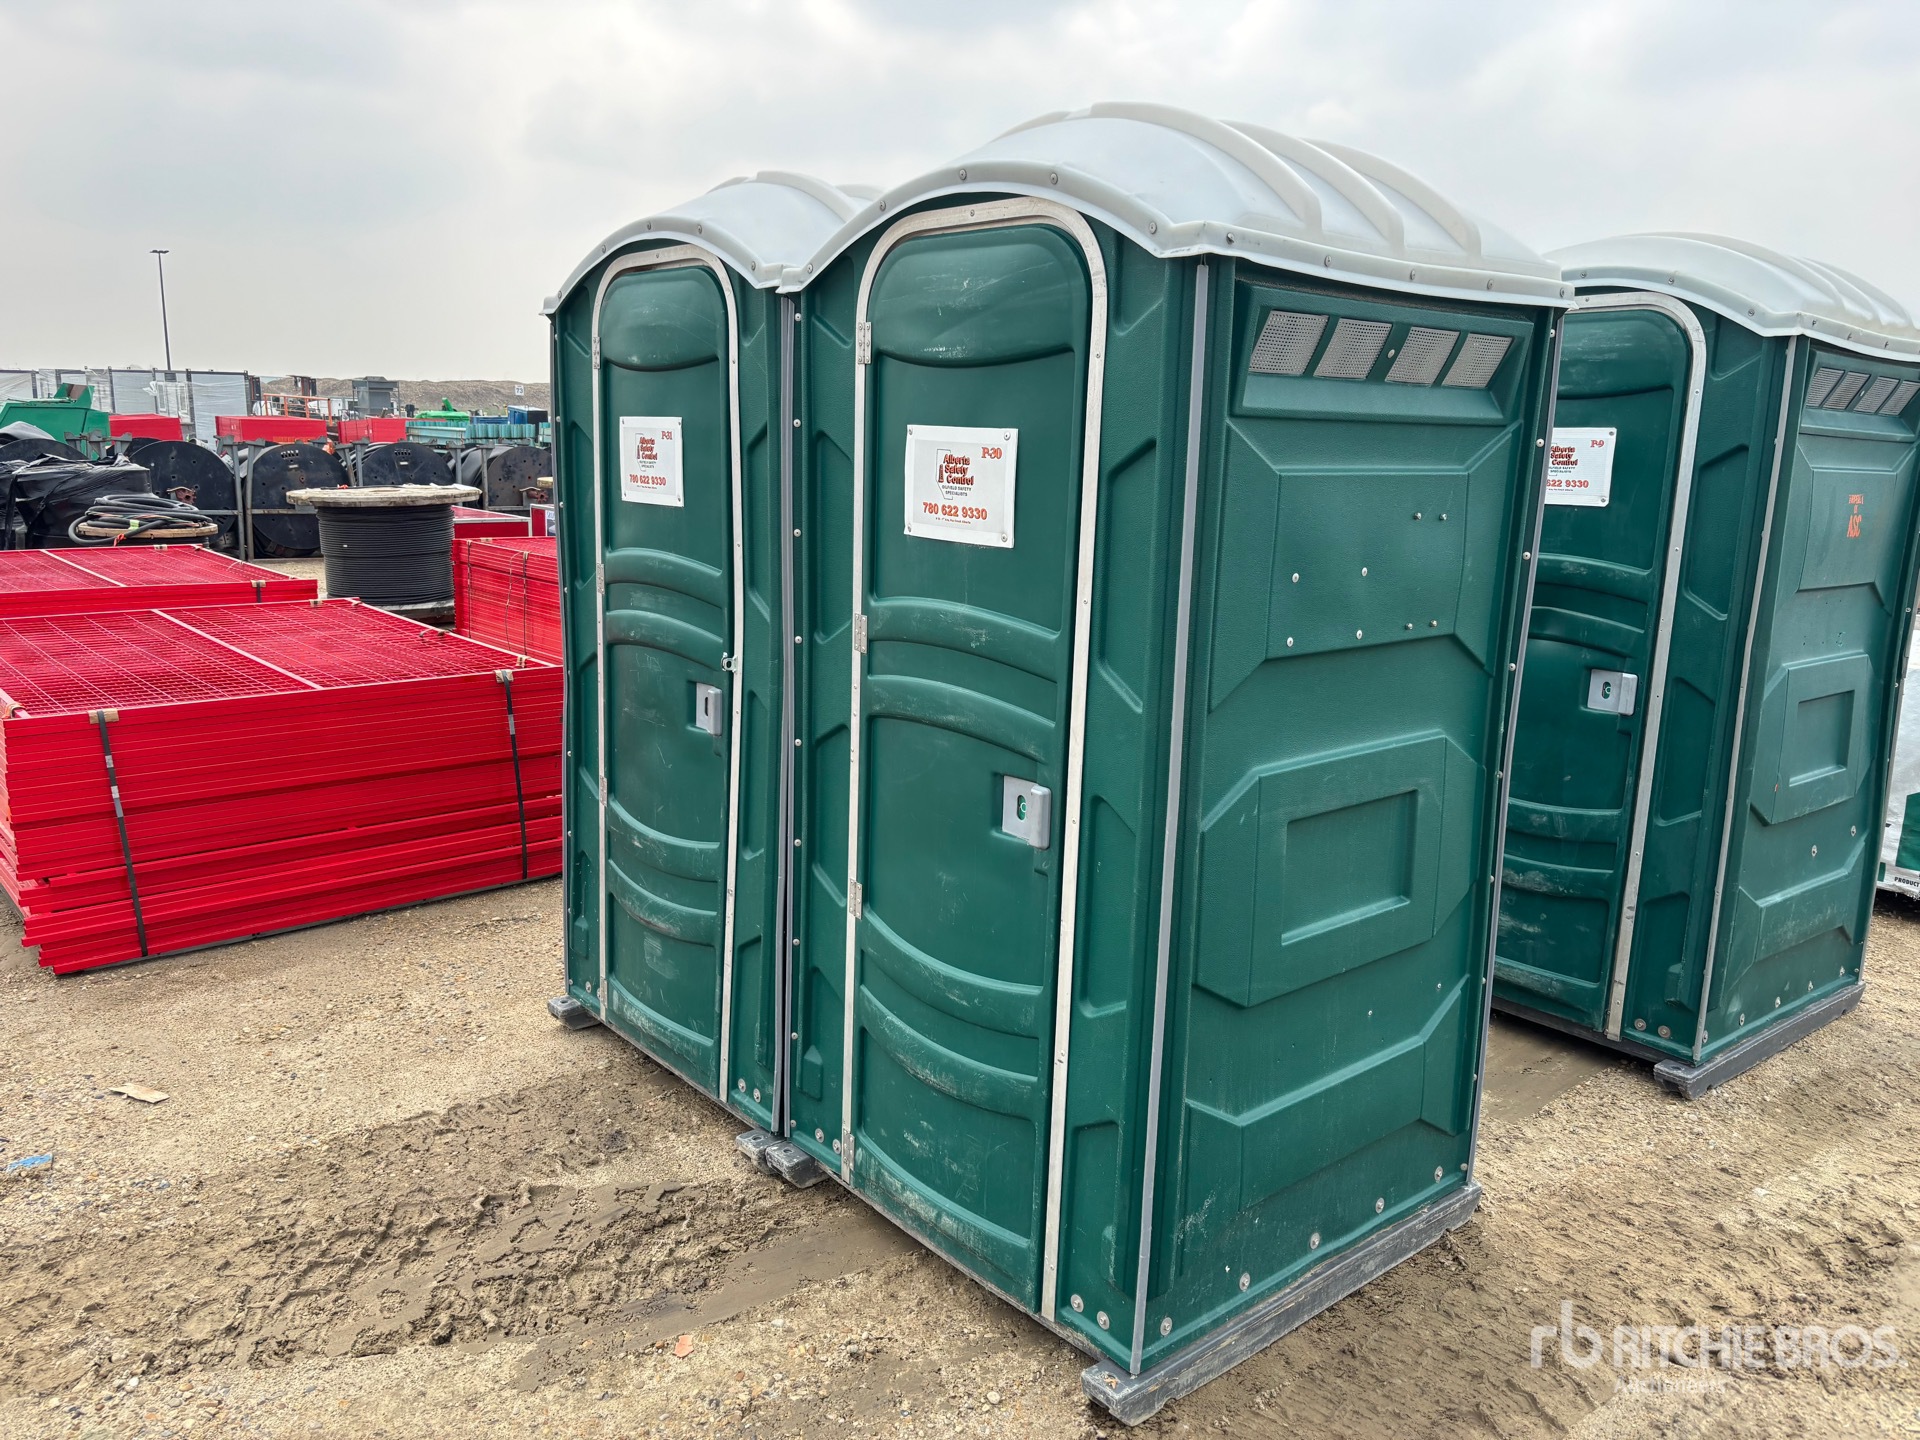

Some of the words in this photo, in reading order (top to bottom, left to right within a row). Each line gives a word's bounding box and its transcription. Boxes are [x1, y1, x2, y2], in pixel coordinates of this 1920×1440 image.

[1590, 439, 1605, 448] P-9
[981, 447, 1002, 459] P-30
[943, 453, 971, 466] Alberta
[944, 464, 968, 477] Safety
[629, 474, 639, 484] 780
[639, 475, 650, 485] 622
[651, 476, 667, 486] 9330
[946, 474, 975, 486] Control
[1565, 479, 1589, 488] 9330
[922, 501, 939, 515] 780
[941, 503, 959, 517] 622
[961, 506, 988, 520] 9330
